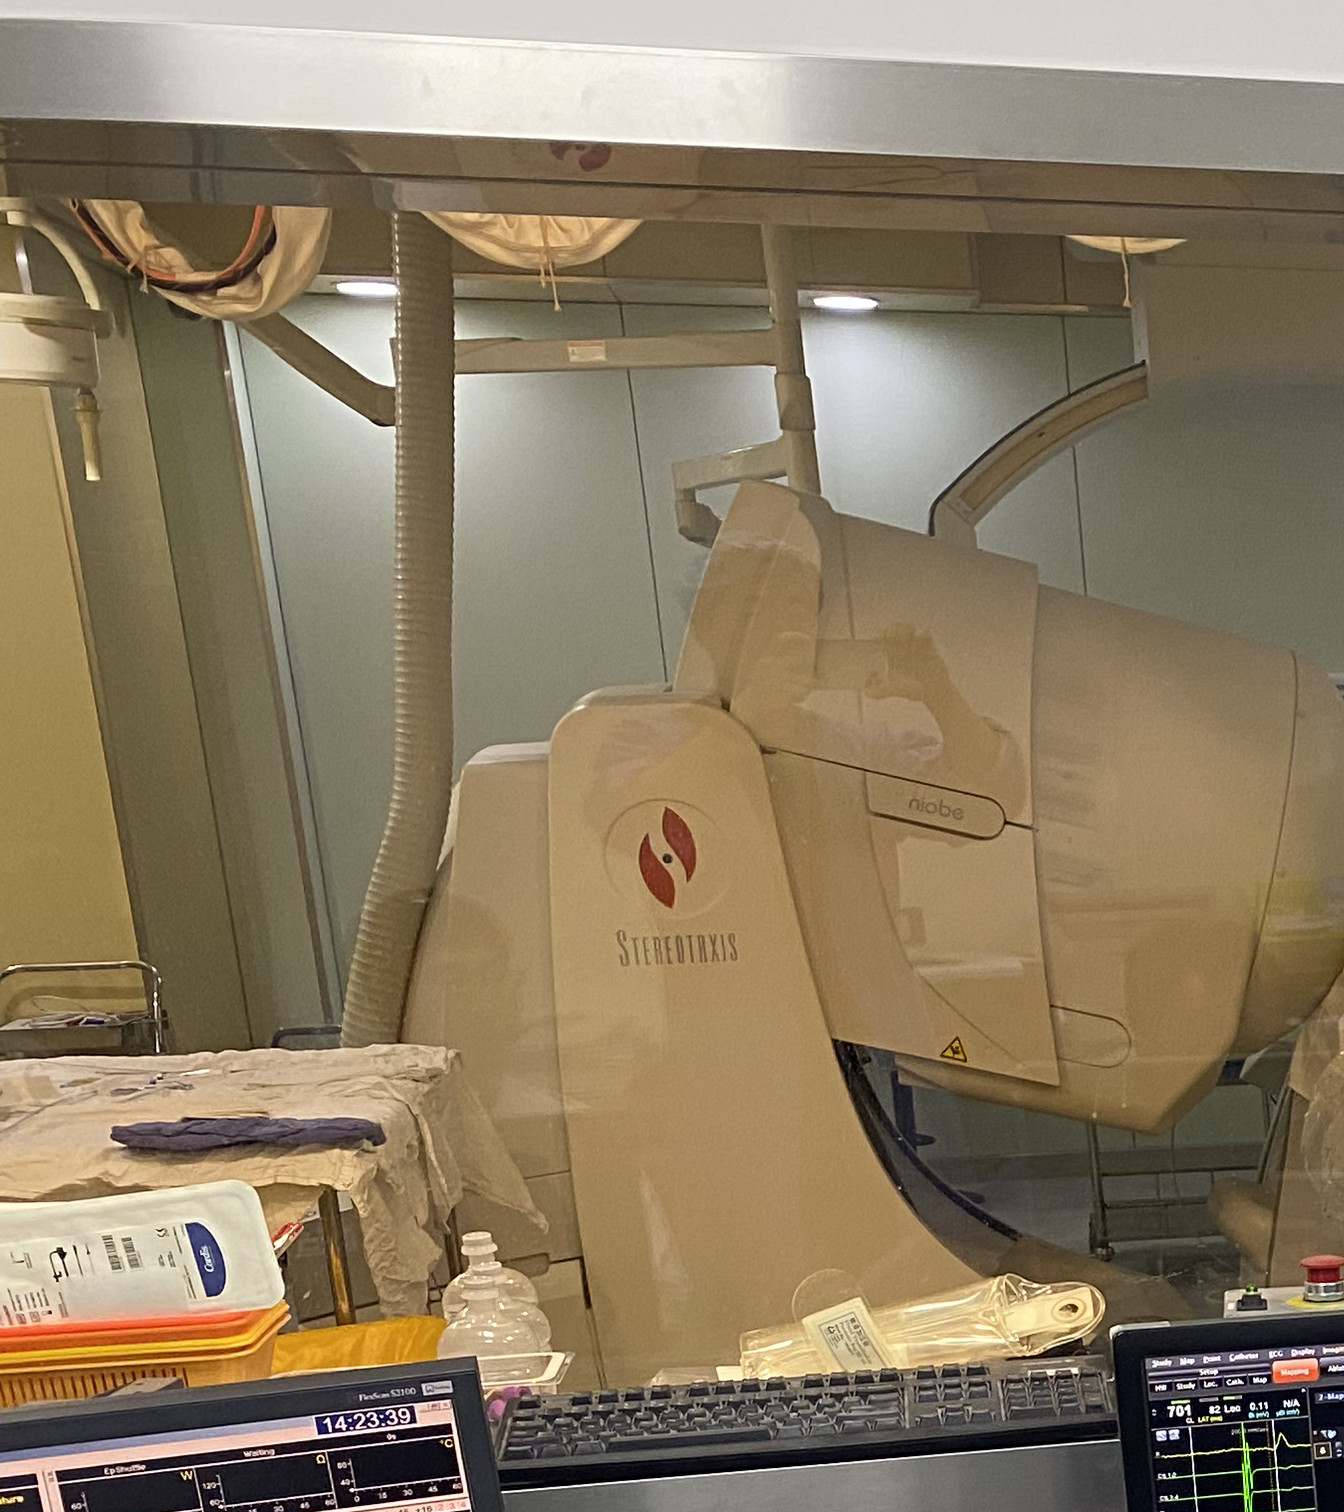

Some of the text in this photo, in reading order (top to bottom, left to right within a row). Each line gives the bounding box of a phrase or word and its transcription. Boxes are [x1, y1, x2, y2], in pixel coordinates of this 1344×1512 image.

[200, 1245, 215, 1272] Cordis
[1152, 1358, 1172, 1367] Study
[1179, 1357, 1195, 1366] Map
[1291, 1347, 1315, 1357] Display
[1176, 1381, 1196, 1391] Study
[1252, 1375, 1267, 1384] Map
[1167, 1405, 1192, 1417] 701
[1283, 1399, 1300, 1408] N/A
[322, 1408, 412, 1433] 14:23:39
[243, 1447, 275, 1458] Waiting
[180, 1470, 193, 1481] W
